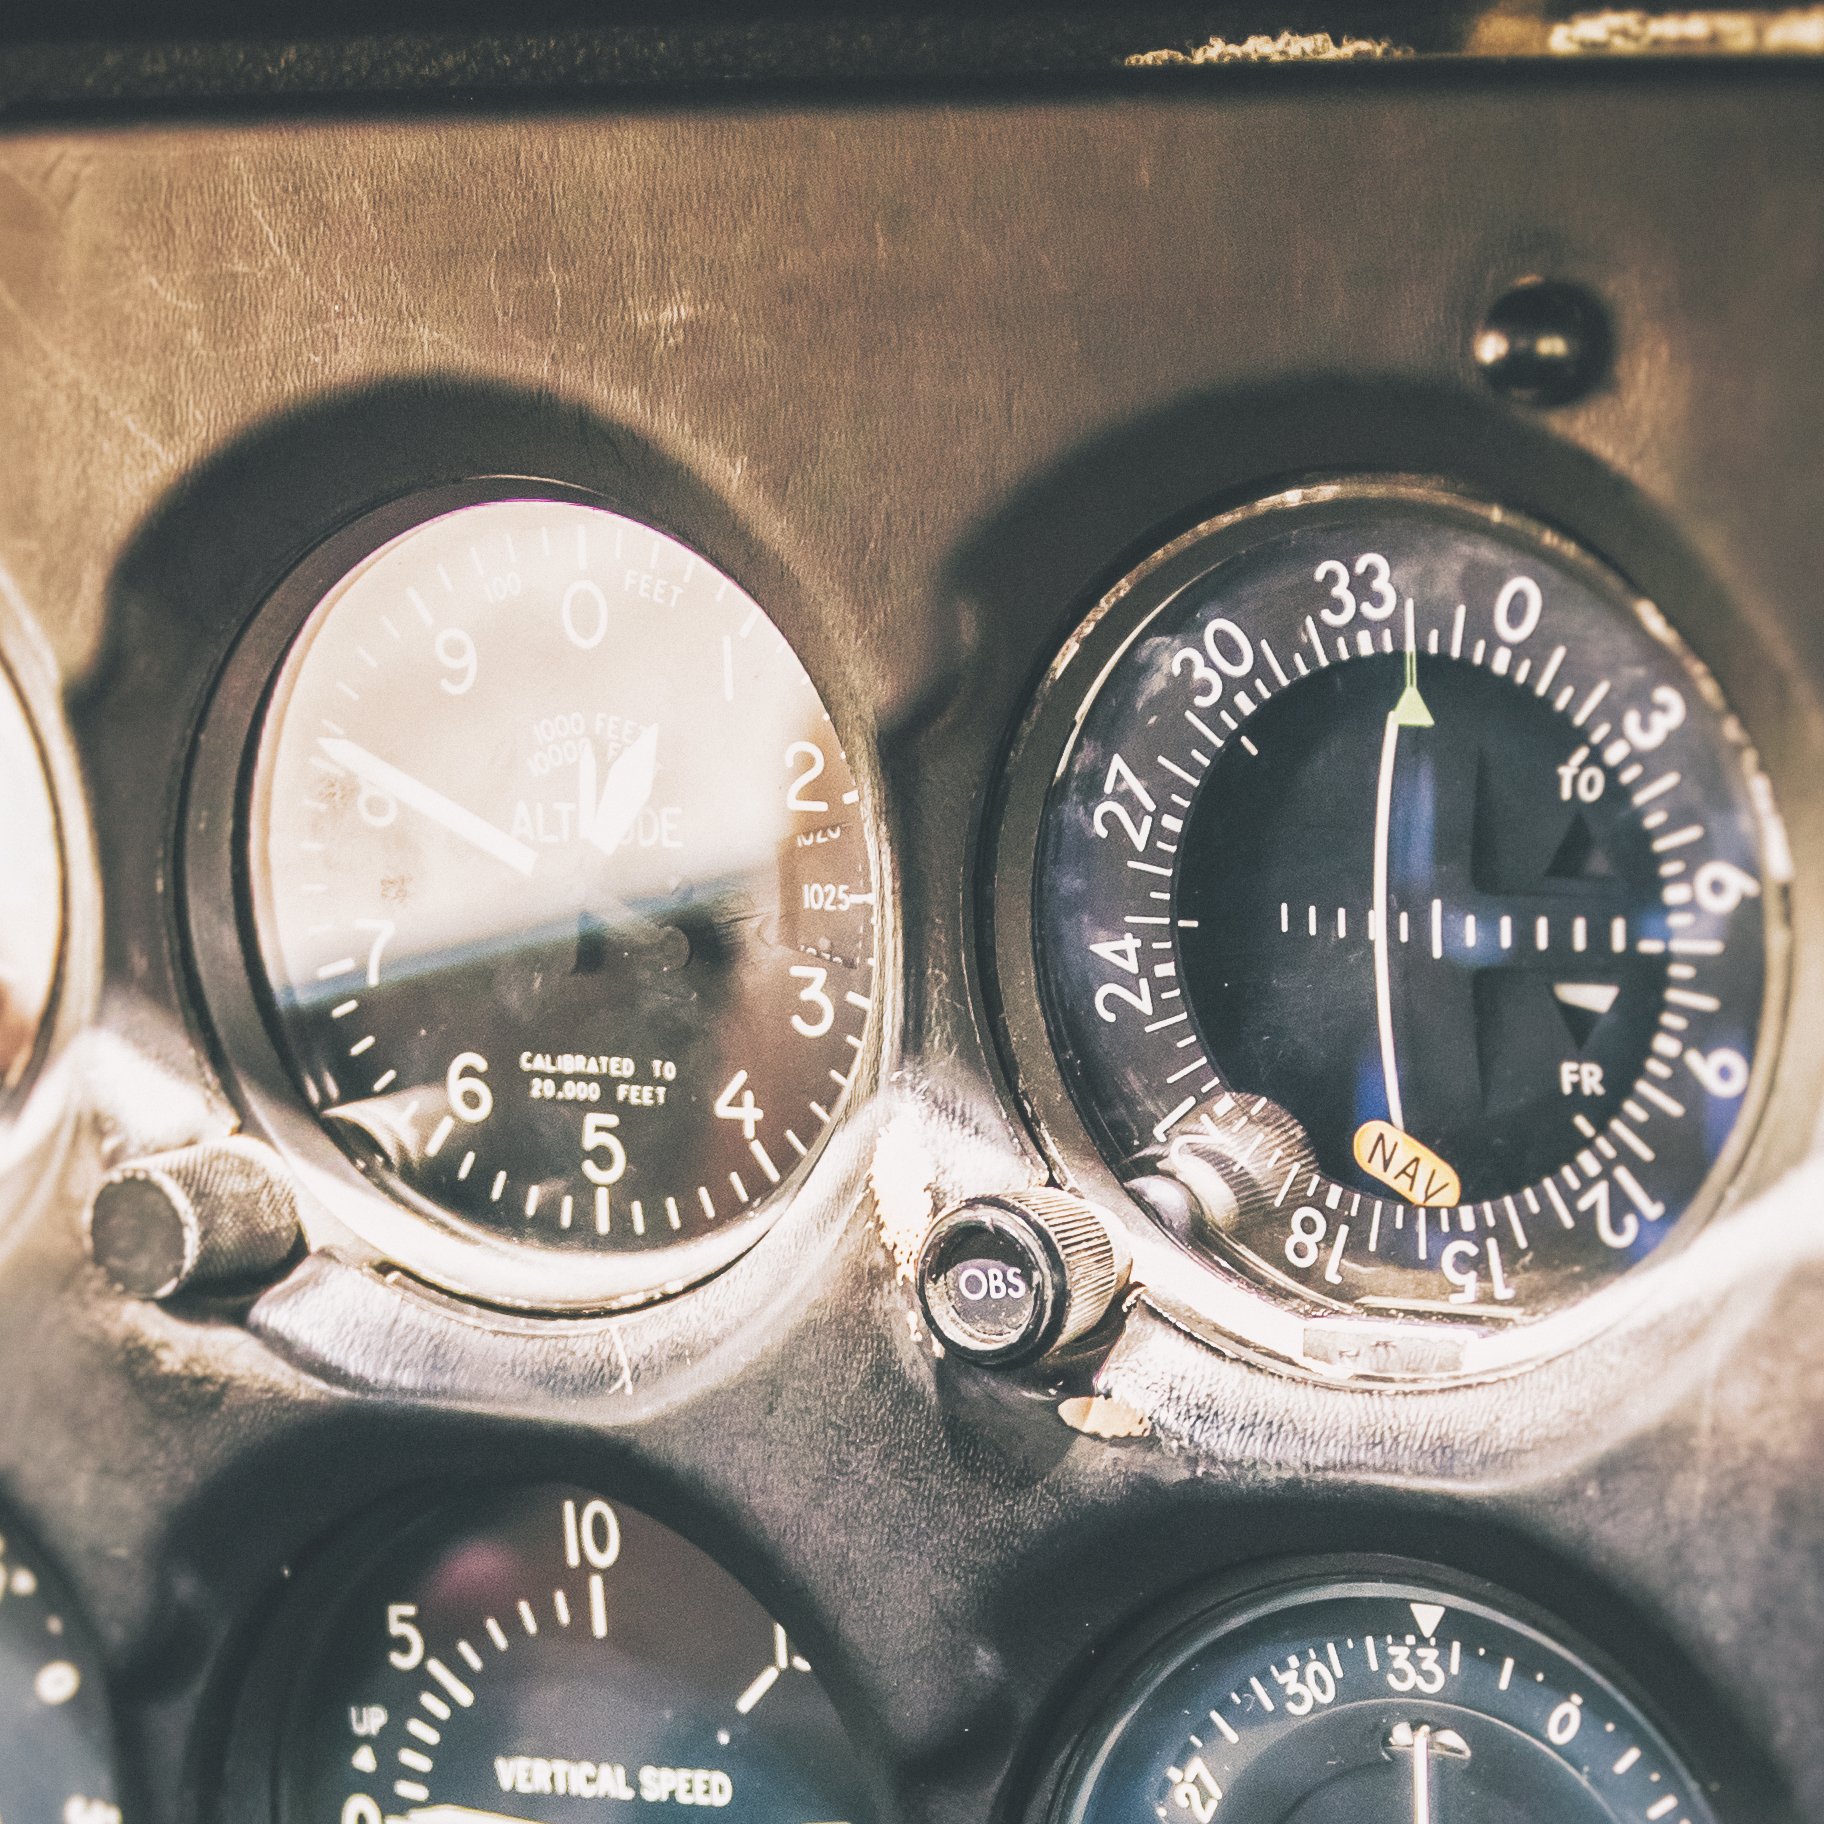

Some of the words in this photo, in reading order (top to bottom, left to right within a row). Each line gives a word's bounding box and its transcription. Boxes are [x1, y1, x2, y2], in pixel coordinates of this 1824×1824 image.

[562, 579, 608, 648] 0
[1314, 553, 1398, 627] 33
[1494, 577, 1542, 643] 0
[435, 627, 478, 694] 9
[1173, 617, 1254, 707] 30
[1623, 686, 1685, 750] 3
[784, 740, 830, 812] 2
[1094, 754, 1157, 851] 27
[1558, 765, 1605, 802] TO
[511, 799, 683, 848] ALTDE
[802, 883, 850, 911] 1025
[1695, 861, 1761, 913] 6
[356, 918, 397, 986] 7
[1090, 936, 1153, 1026] 24
[789, 965, 835, 1038] 3
[446, 1052, 492, 1122] 6
[519, 1051, 635, 1078] CALIBRATED
[651, 1059, 677, 1081] TO
[616, 1083, 667, 1106] FEET
[1560, 1063, 1604, 1097] FR
[1683, 1048, 1748, 1097] 9
[715, 1072, 763, 1139] 4
[582, 1113, 626, 1185] 5
[1368, 1132, 1449, 1204] NAV
[1579, 1164, 1665, 1248] 12
[1284, 1206, 1349, 1284] 18
[1441, 1239, 1516, 1304] 15
[959, 1267, 1025, 1300] OBS
[564, 1500, 620, 1569] 10
[386, 1605, 424, 1671] 5
[1277, 1660, 1336, 1716] 30
[1387, 1645, 1446, 1695] 33
[350, 1704, 389, 1737] UP
[1547, 1704, 1580, 1744] 0
[494, 1756, 636, 1801] VERTICAL
[639, 1764, 733, 1807] SPEED
[1173, 1756, 1224, 1824] 27
